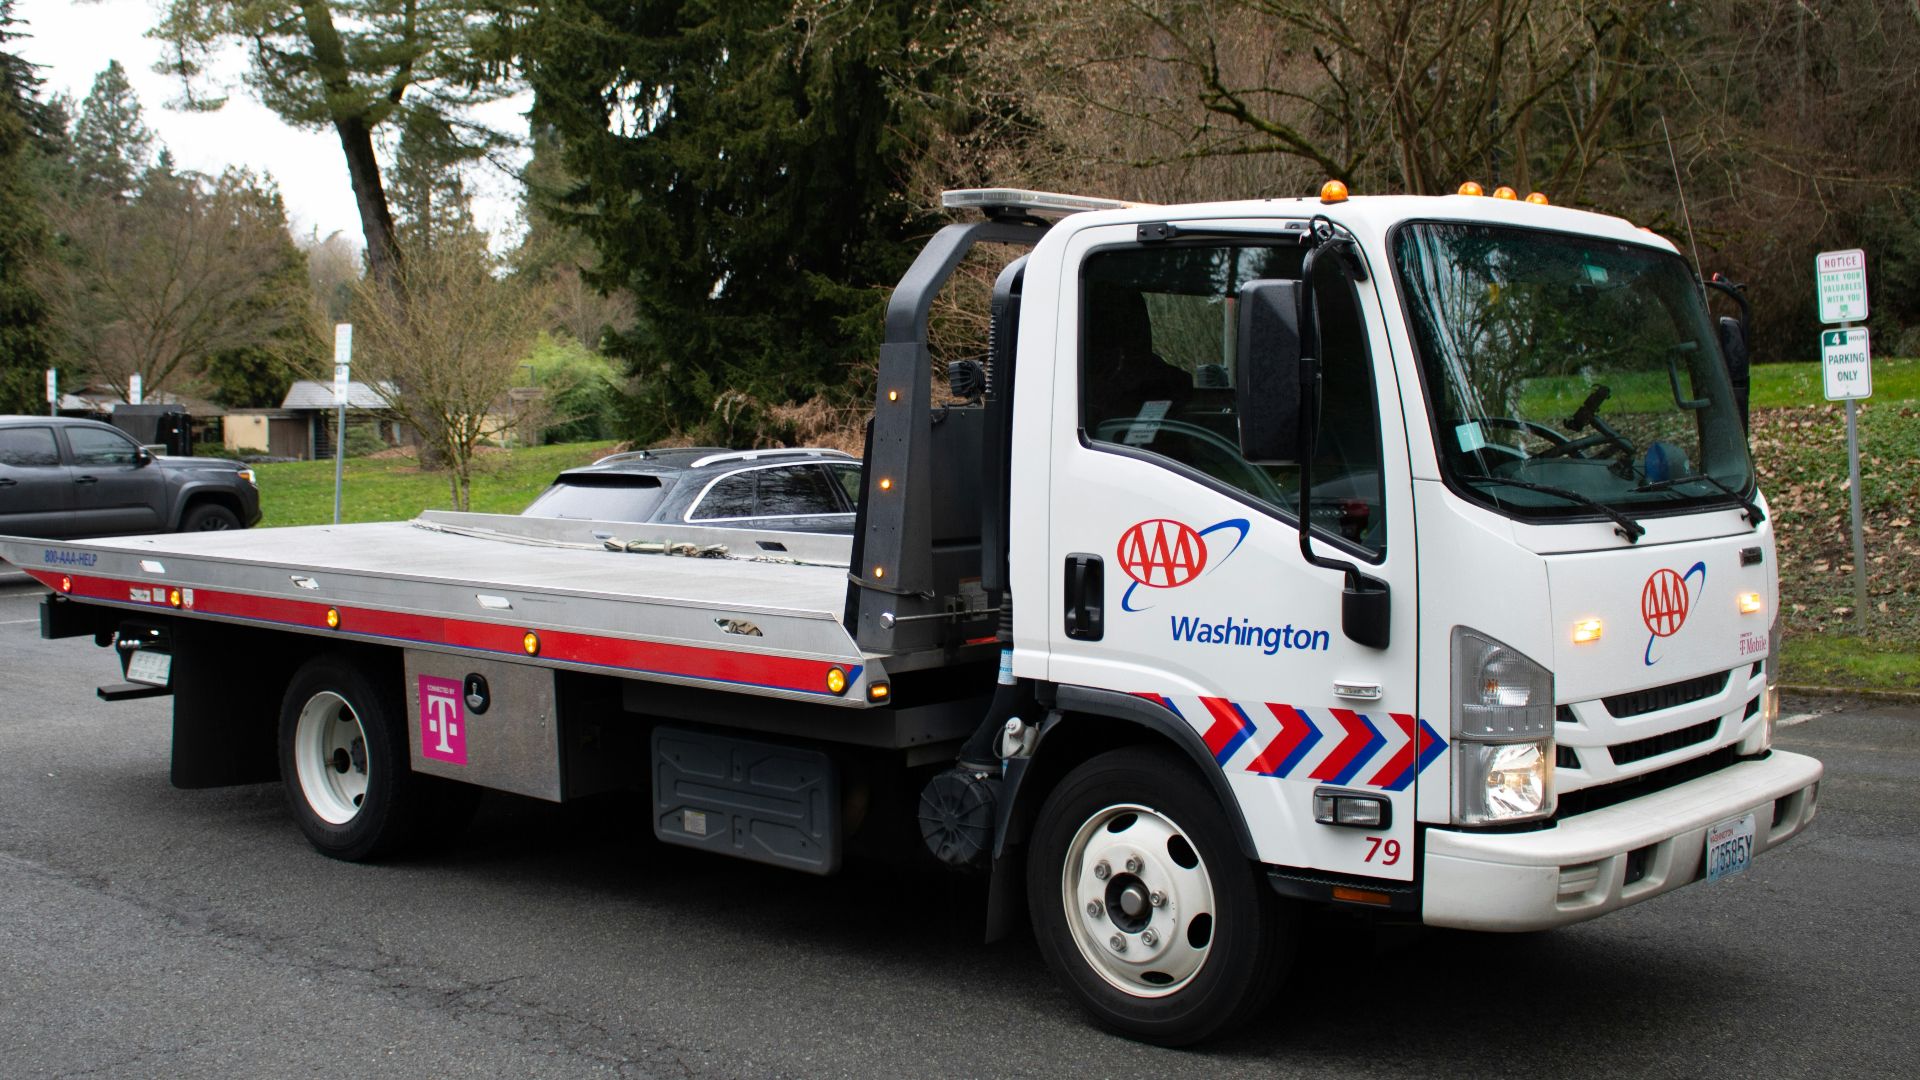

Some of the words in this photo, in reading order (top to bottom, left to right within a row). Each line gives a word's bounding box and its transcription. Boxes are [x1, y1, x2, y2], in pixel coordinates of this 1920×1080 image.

[1824, 256, 1856, 268] NOTICE
[1823, 274, 1839, 282] TAKE
[1843, 271, 1861, 281] YOUR
[1824, 282, 1862, 293] VALUABLES
[1827, 294, 1844, 304] WITH
[1848, 293, 1860, 302] YOU
[1831, 333, 1841, 346] 4
[1828, 352, 1865, 365] PARKING
[1837, 371, 1858, 382] ONLY
[45, 549, 97, 566] 800-AAA-HELP
[1126, 519, 1200, 588] AAA
[1647, 570, 1686, 636] AAA
[1171, 615, 1330, 655] Washington
[1364, 836, 1401, 866] 79
